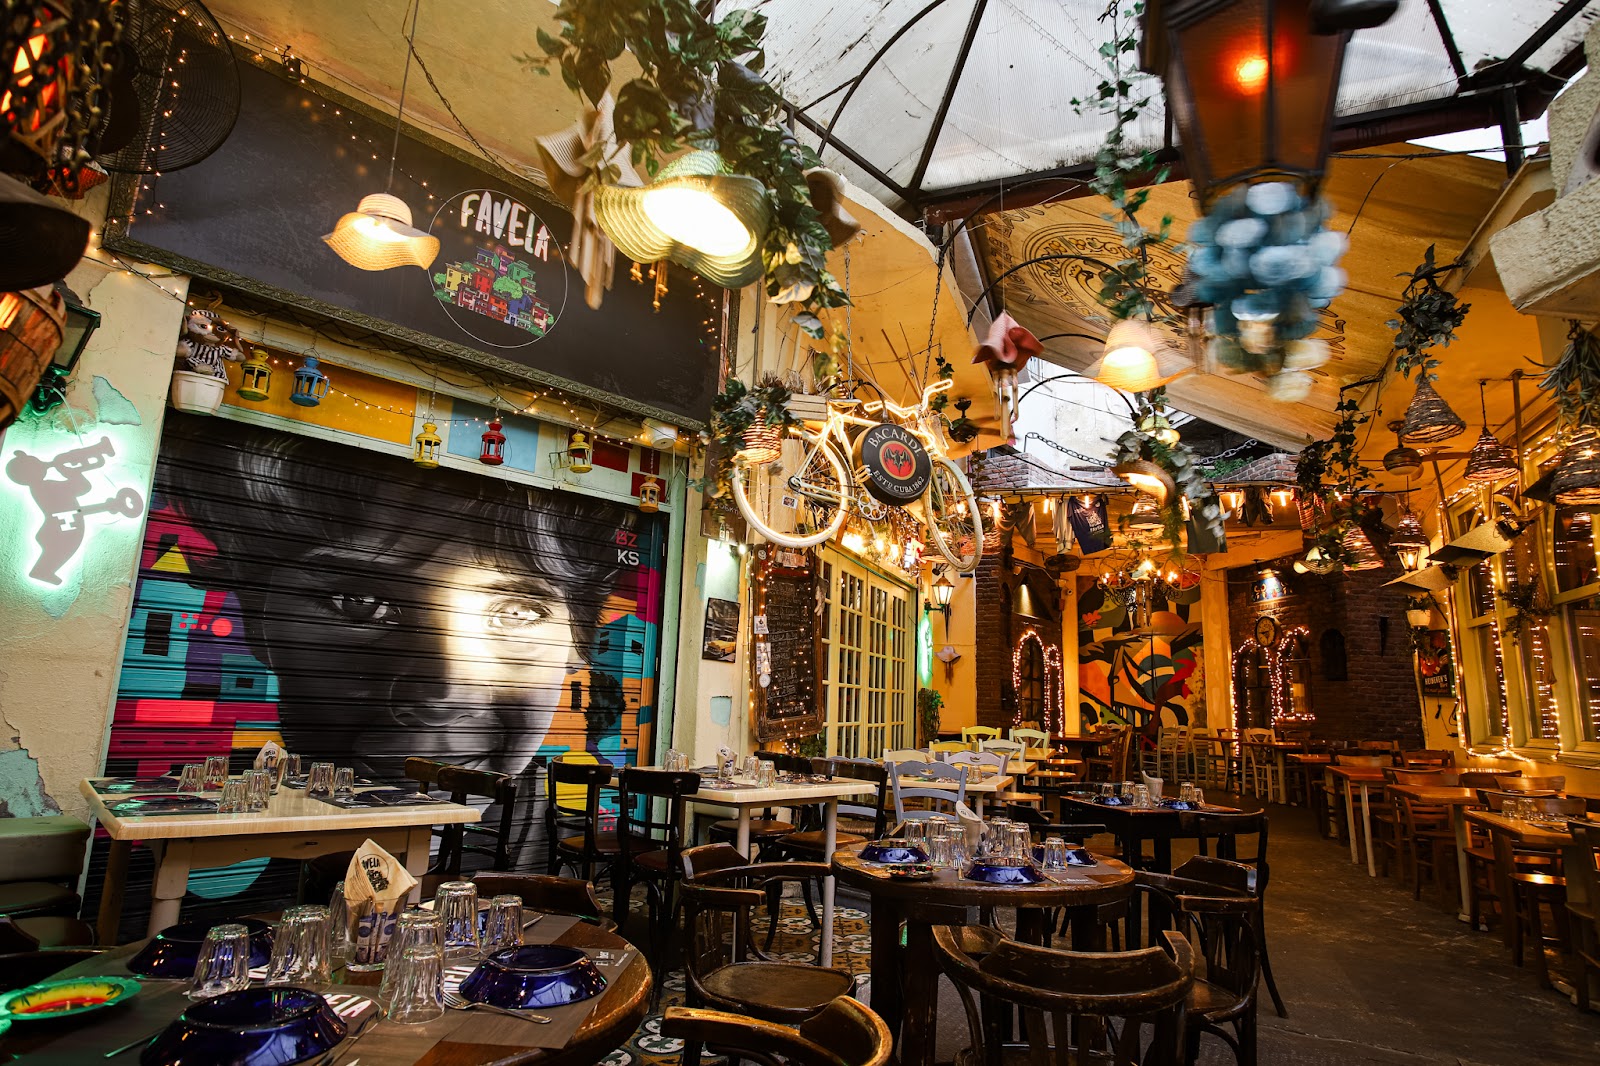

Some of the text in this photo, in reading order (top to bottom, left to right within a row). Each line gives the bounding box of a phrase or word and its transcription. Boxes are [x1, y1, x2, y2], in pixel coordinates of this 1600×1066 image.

[460, 191, 549, 262] FAVELA
[867, 428, 922, 454] BACARDI
[893, 483, 914, 493] CUBA
[912, 476, 925, 491] 1862
[617, 548, 640, 566] KS
